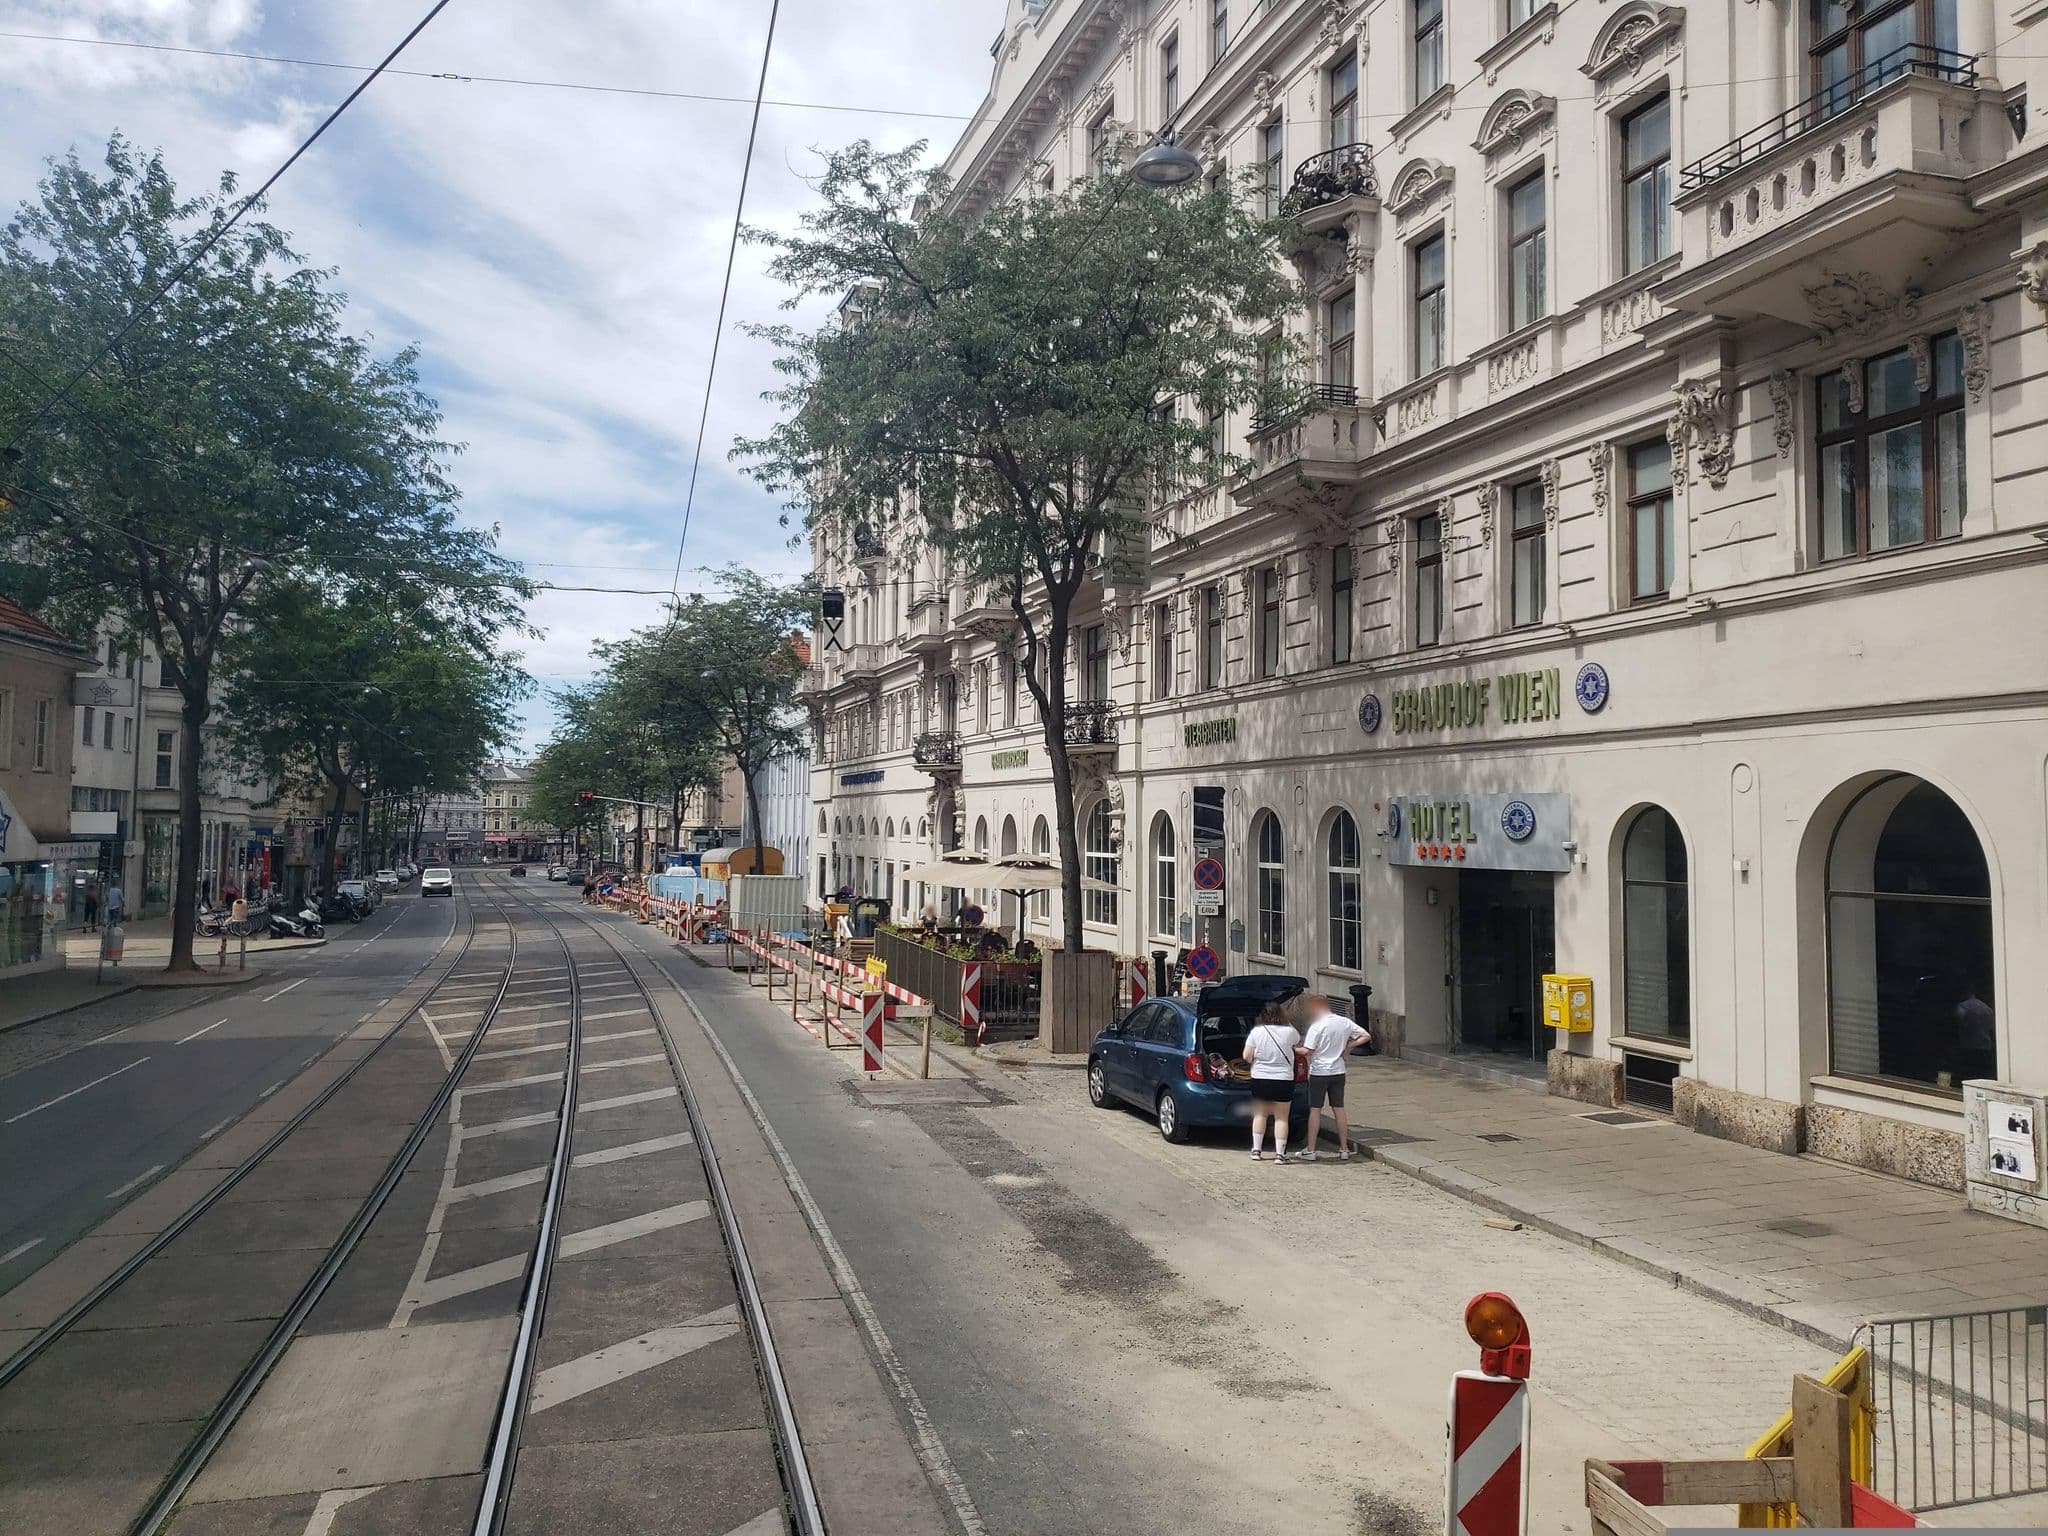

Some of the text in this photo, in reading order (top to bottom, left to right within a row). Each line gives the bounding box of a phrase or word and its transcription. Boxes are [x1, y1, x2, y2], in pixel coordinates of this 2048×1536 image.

[1391, 677, 1490, 734] BRAUHOF
[1497, 667, 1561, 724] WIEN
[1184, 717, 1236, 748] BIERGARTEN
[1409, 801, 1477, 843] HOTEL
